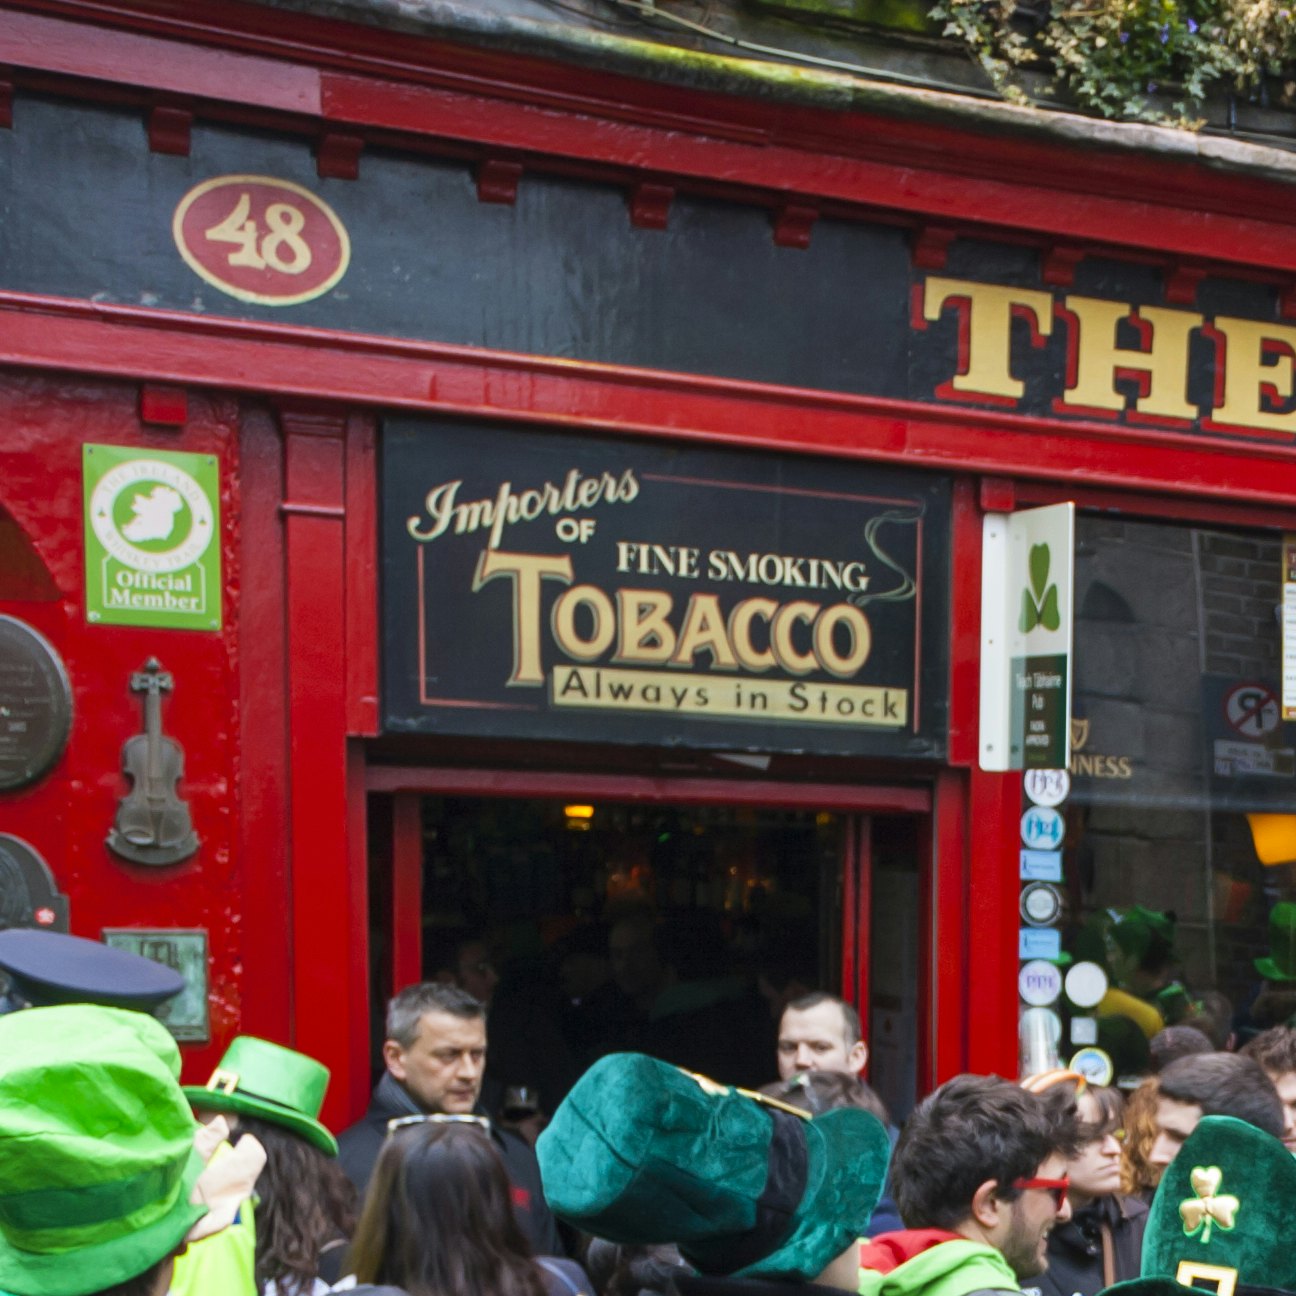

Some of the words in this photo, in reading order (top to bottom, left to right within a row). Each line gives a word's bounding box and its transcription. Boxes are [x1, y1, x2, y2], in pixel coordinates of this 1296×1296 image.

[205, 193, 312, 275] 48
[407, 468, 640, 550] Importers
[555, 519, 596, 544] OF
[116, 570, 192, 592] Official
[616, 540, 700, 577] FINE
[708, 551, 871, 592] SMOKING
[110, 588, 199, 610] Member
[471, 549, 872, 688] TOBACCO
[561, 669, 710, 707] Always
[735, 684, 769, 711] in
[788, 685, 898, 719] Stock
